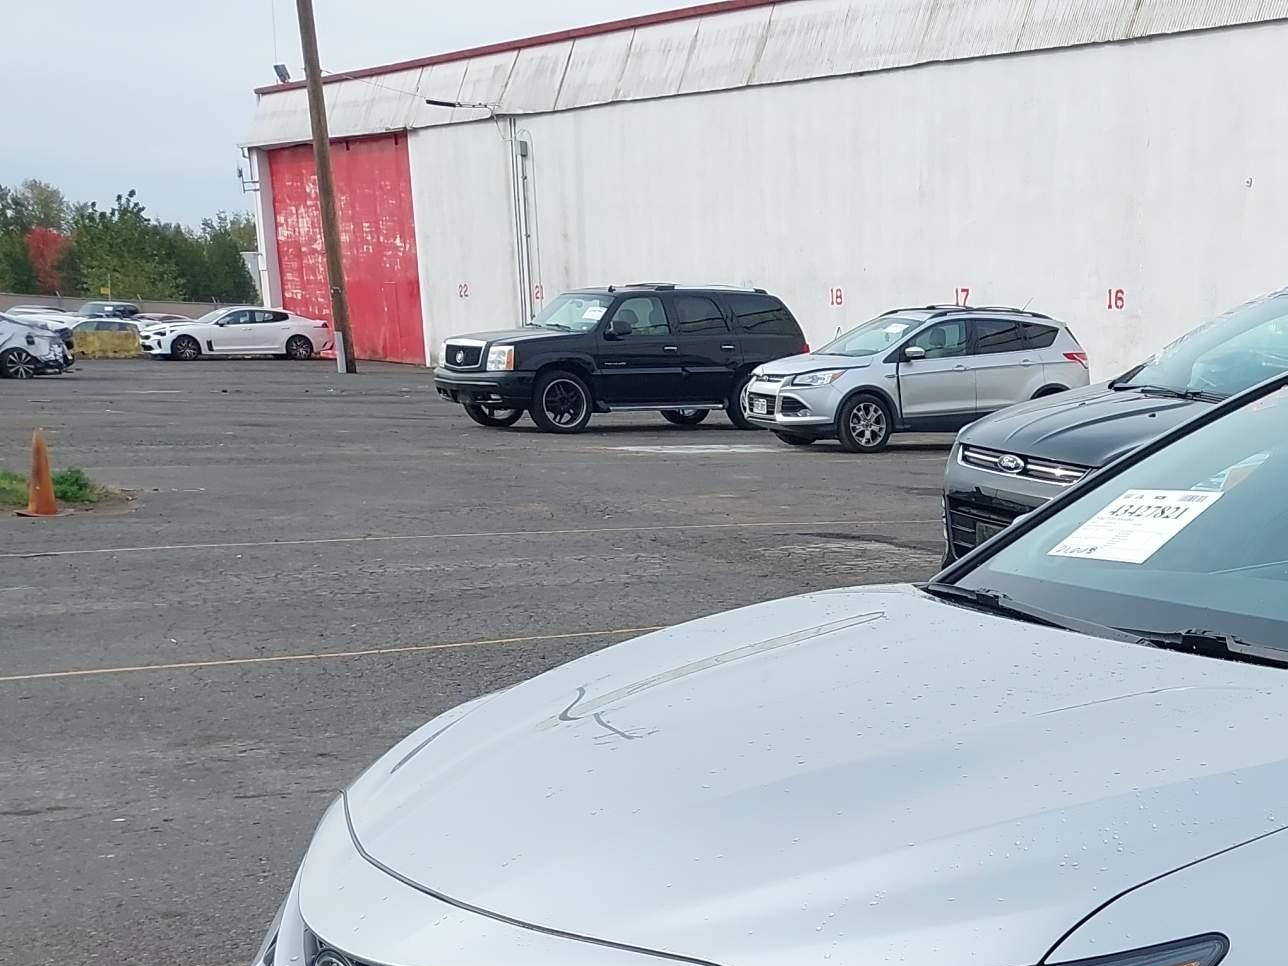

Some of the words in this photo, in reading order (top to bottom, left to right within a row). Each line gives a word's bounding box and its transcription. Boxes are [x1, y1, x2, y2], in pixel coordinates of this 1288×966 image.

[458, 283, 469, 298] 22
[534, 285, 544, 300] 21
[830, 287, 843, 306] 18
[955, 288, 970, 307] 17
[1107, 288, 1125, 310] 16
[1109, 504, 1191, 520] 43427821
